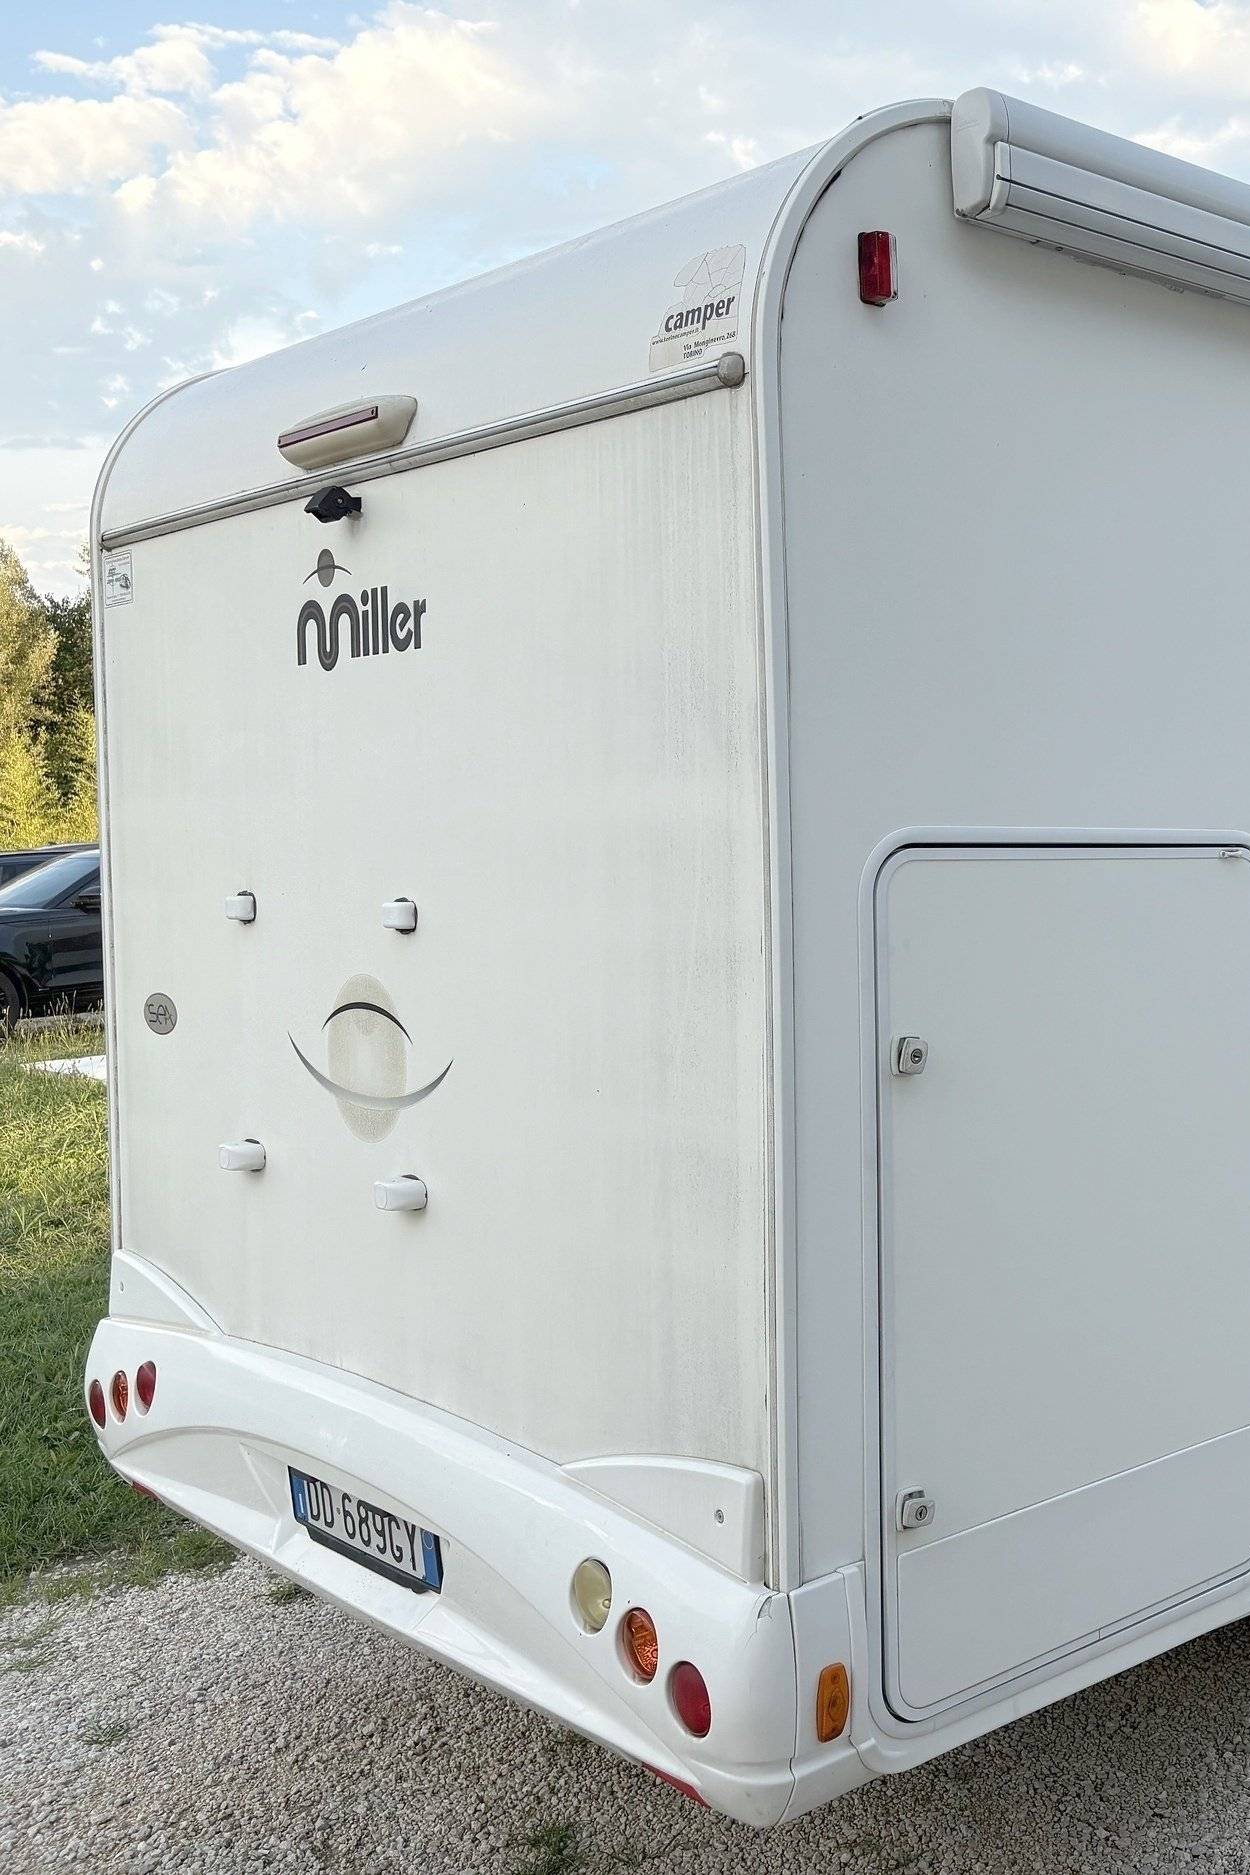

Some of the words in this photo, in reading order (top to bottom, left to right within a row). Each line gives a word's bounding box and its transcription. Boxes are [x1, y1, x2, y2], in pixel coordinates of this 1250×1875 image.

[664, 296, 736, 333] camper
[682, 343, 692, 352] Via
[682, 348, 704, 360] TORINO
[307, 1481, 335, 1529] DD
[341, 1492, 417, 1571] 689GY
